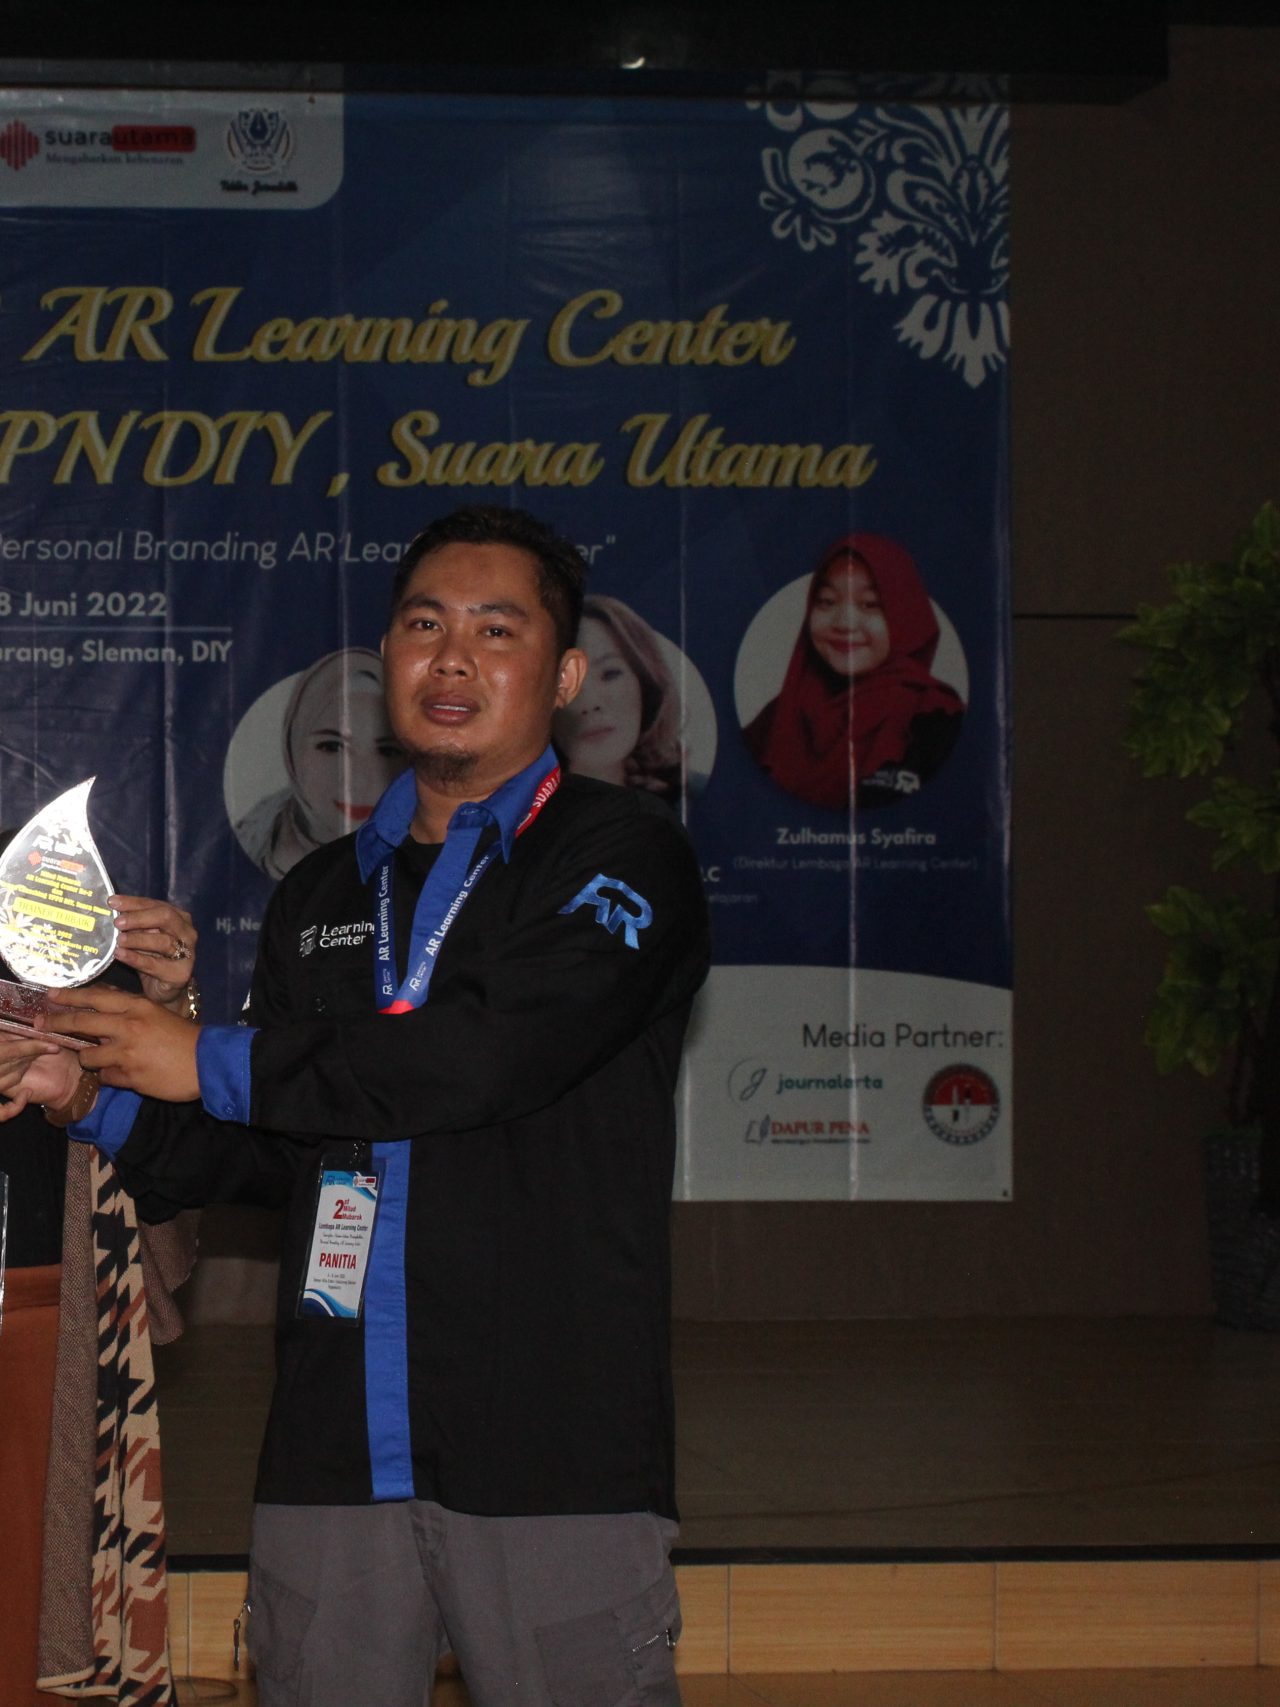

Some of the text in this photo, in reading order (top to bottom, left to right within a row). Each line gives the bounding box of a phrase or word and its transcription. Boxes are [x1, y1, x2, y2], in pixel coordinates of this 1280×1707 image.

[21, 284, 175, 363] AR
[190, 284, 530, 387] Learning
[546, 288, 796, 368] Center
[376, 409, 607, 488] Suara
[618, 411, 880, 488] Utama
[133, 530, 277, 569] Branding
[287, 531, 335, 562] AR
[19, 592, 78, 617] Juni
[86, 592, 167, 617] 2022
[81, 639, 184, 666] Sleman,
[191, 640, 233, 662] DIY
[871, 828, 936, 849] Syafira
[379, 865, 389, 898] Center
[425, 855, 490, 957] AR Learning Center
[378, 898, 391, 944] Learning
[319, 935, 366, 948] Center
[378, 945, 390, 961] AR
[803, 1023, 1004, 1048] Media Partner:
[333, 1199, 345, 1219] 2
[319, 1252, 358, 1269] PANITIA
